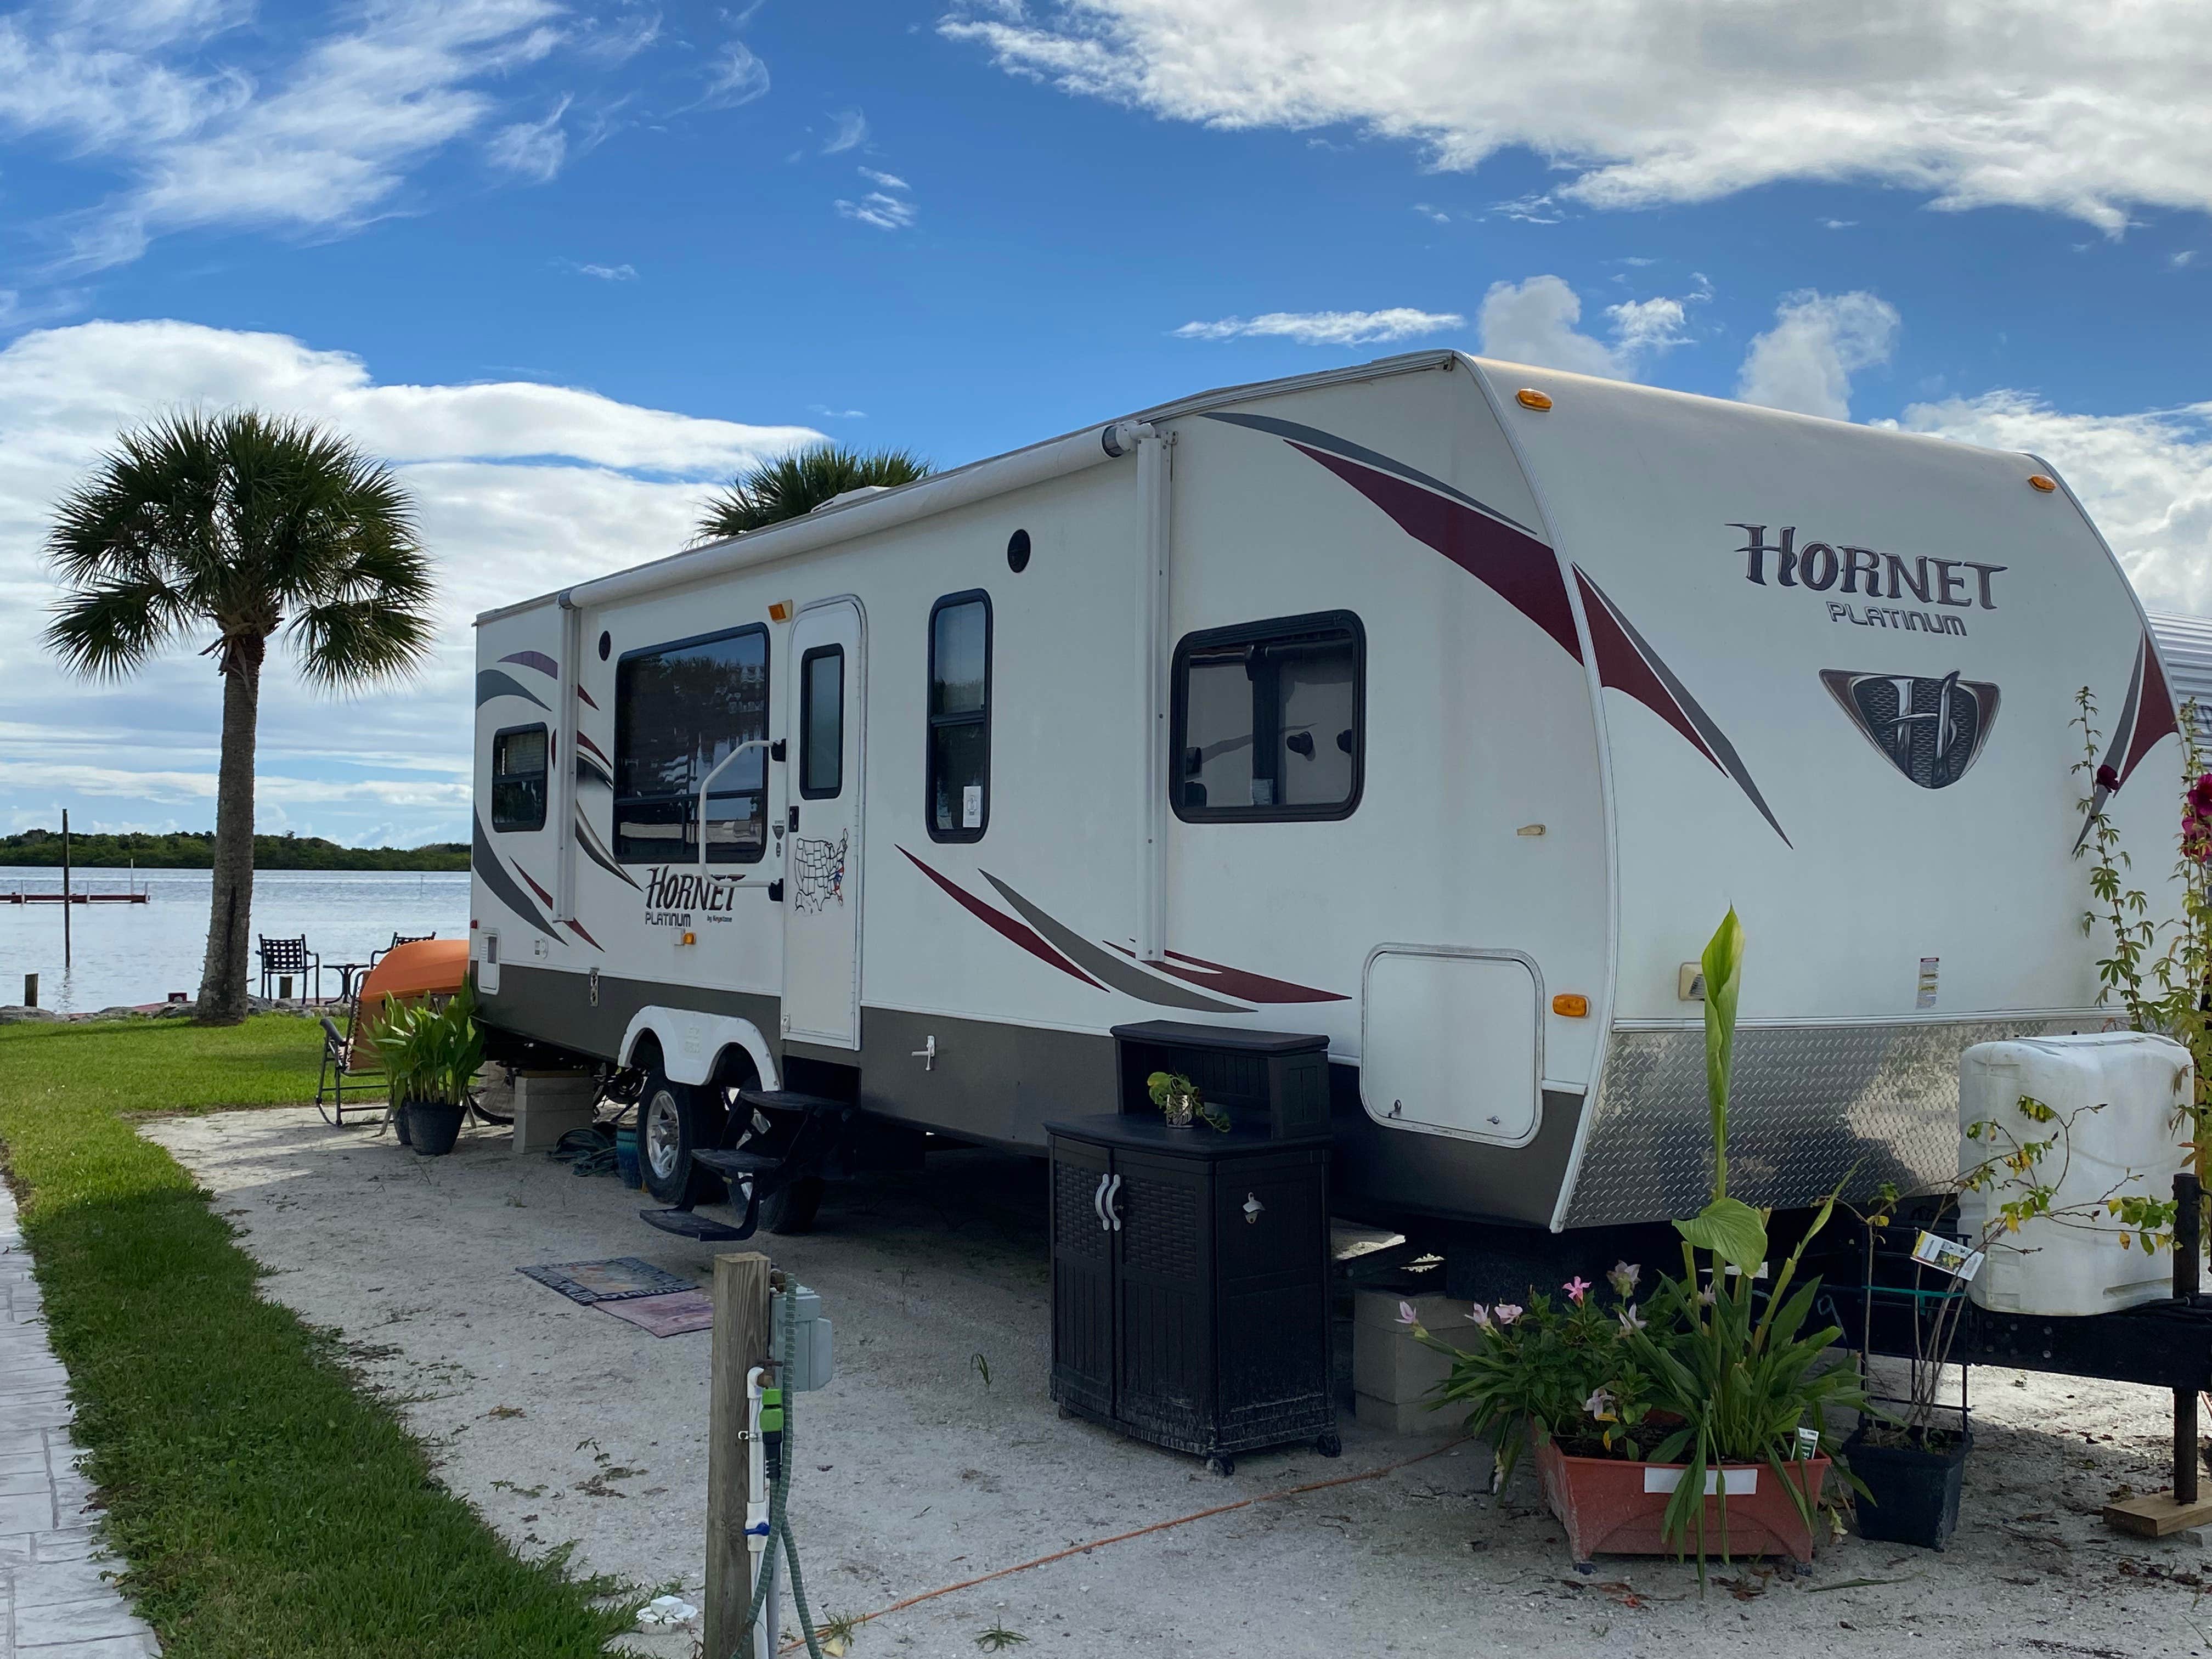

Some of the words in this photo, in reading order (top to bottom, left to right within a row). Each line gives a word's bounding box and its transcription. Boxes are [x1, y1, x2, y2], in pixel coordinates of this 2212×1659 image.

[1724, 523, 2008, 610] HORNET
[1826, 602, 1967, 636] PLATINUM
[646, 865, 746, 911] HORNET
[646, 912, 691, 927] PLATINUM
